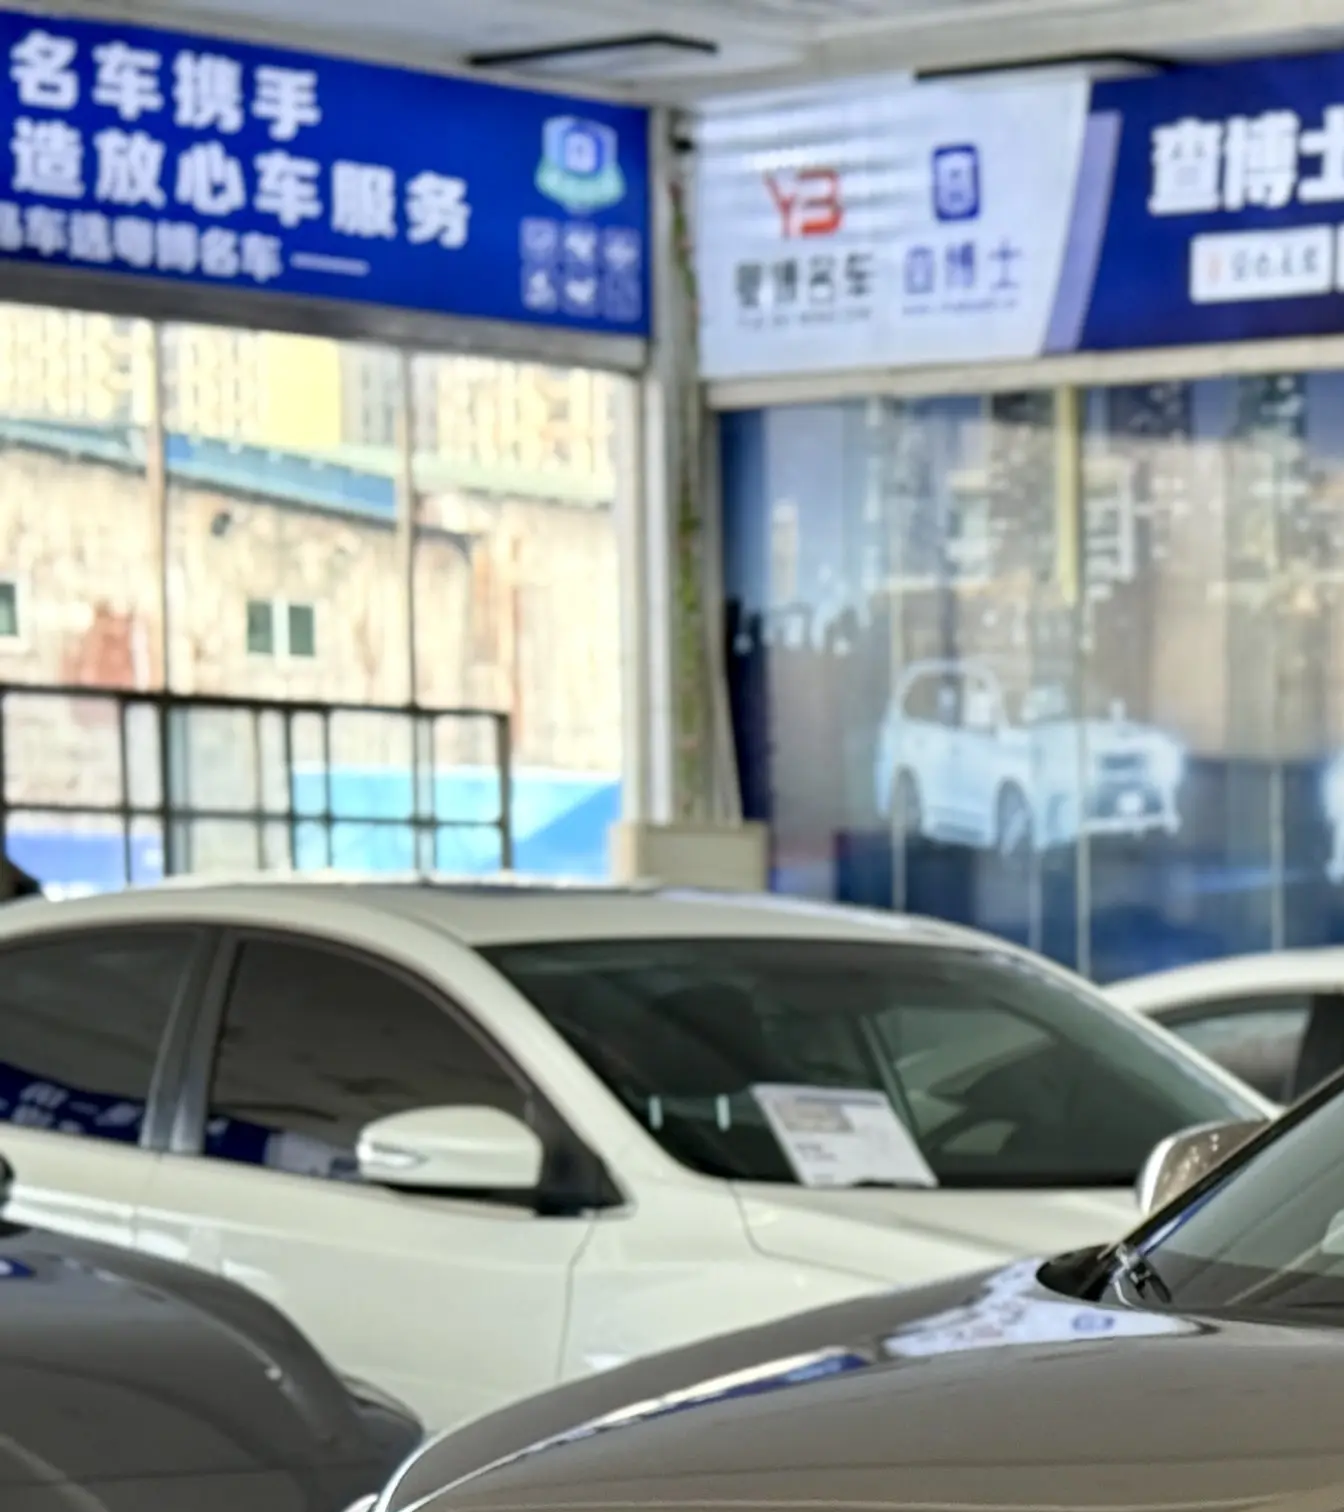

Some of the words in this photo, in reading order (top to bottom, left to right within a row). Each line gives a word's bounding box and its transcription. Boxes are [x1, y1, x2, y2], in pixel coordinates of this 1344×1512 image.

[11, 30, 321, 140] 名车携手
[11, 117, 471, 249] 造放心车服务
